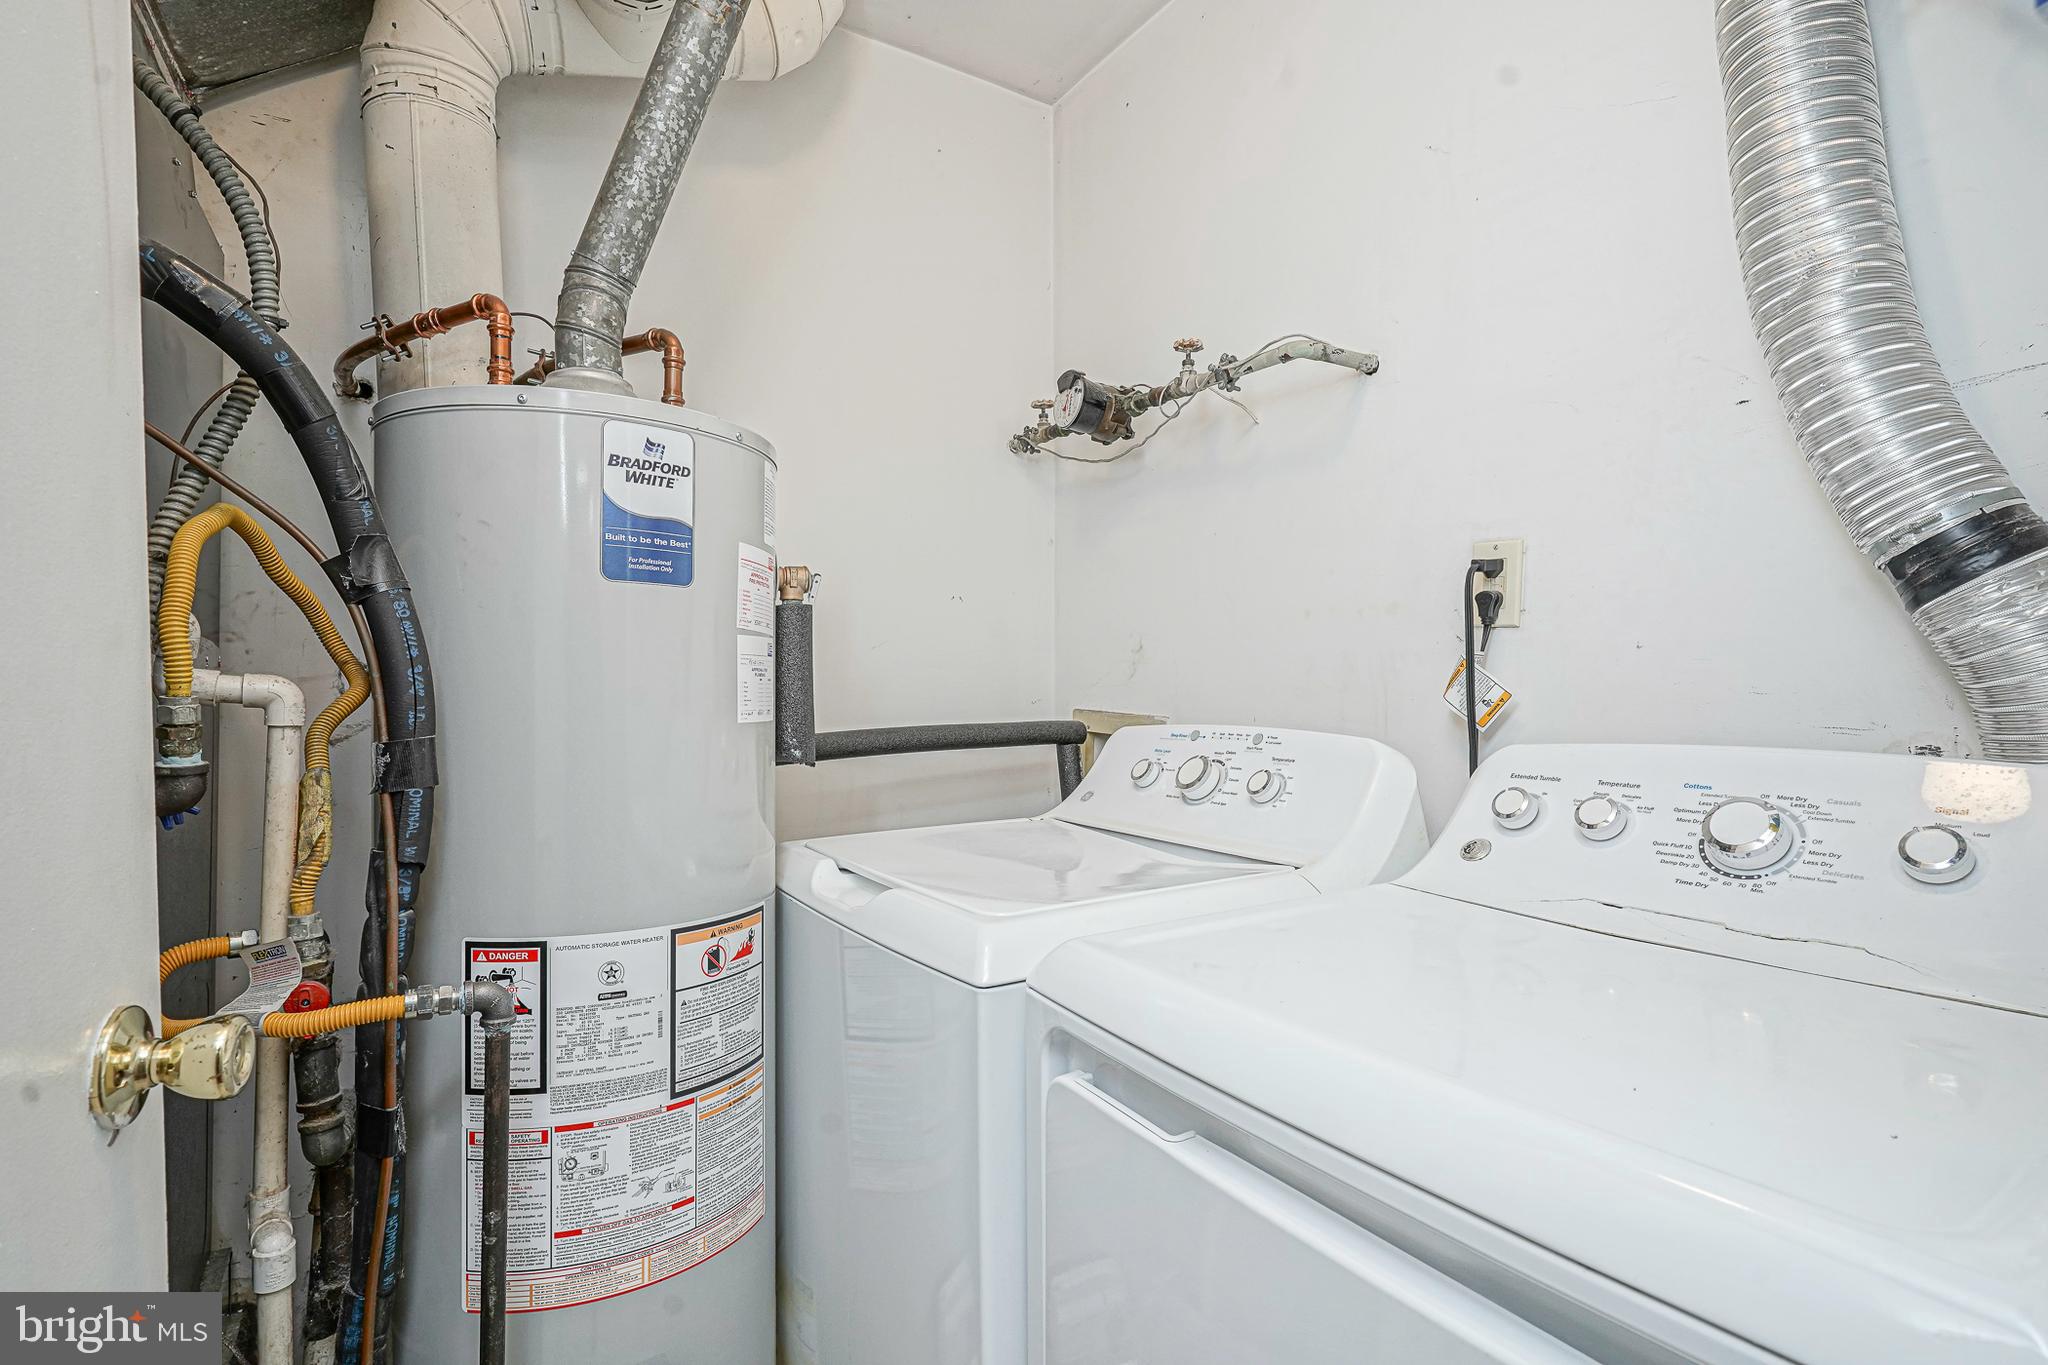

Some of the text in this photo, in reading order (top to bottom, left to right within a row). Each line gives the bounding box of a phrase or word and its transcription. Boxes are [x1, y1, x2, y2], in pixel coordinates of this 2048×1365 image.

[608, 454, 690, 477] BRADFORD
[625, 470, 675, 488] WHITE
[606, 533, 625, 541] Built
[640, 535, 651, 544] be
[654, 537, 667, 545] the
[670, 539, 688, 548] Best
[639, 558, 672, 566] Professional
[628, 563, 673, 573] Installation Only
[1598, 779, 1641, 789] Temperature
[1827, 798, 1862, 807] Casuals
[406, 788, 423, 840] OMINAL
[1935, 806, 1969, 816] Signal
[1660, 859, 1678, 867] Damp
[1822, 870, 1864, 880] Delicates
[1675, 879, 1709, 889] Time Dry
[718, 923, 743, 936] WARNING
[252, 945, 286, 960] FLEXTRON
[598, 1116, 626, 1126] OPERATING
[642, 1208, 667, 1221] APPLIANCE
